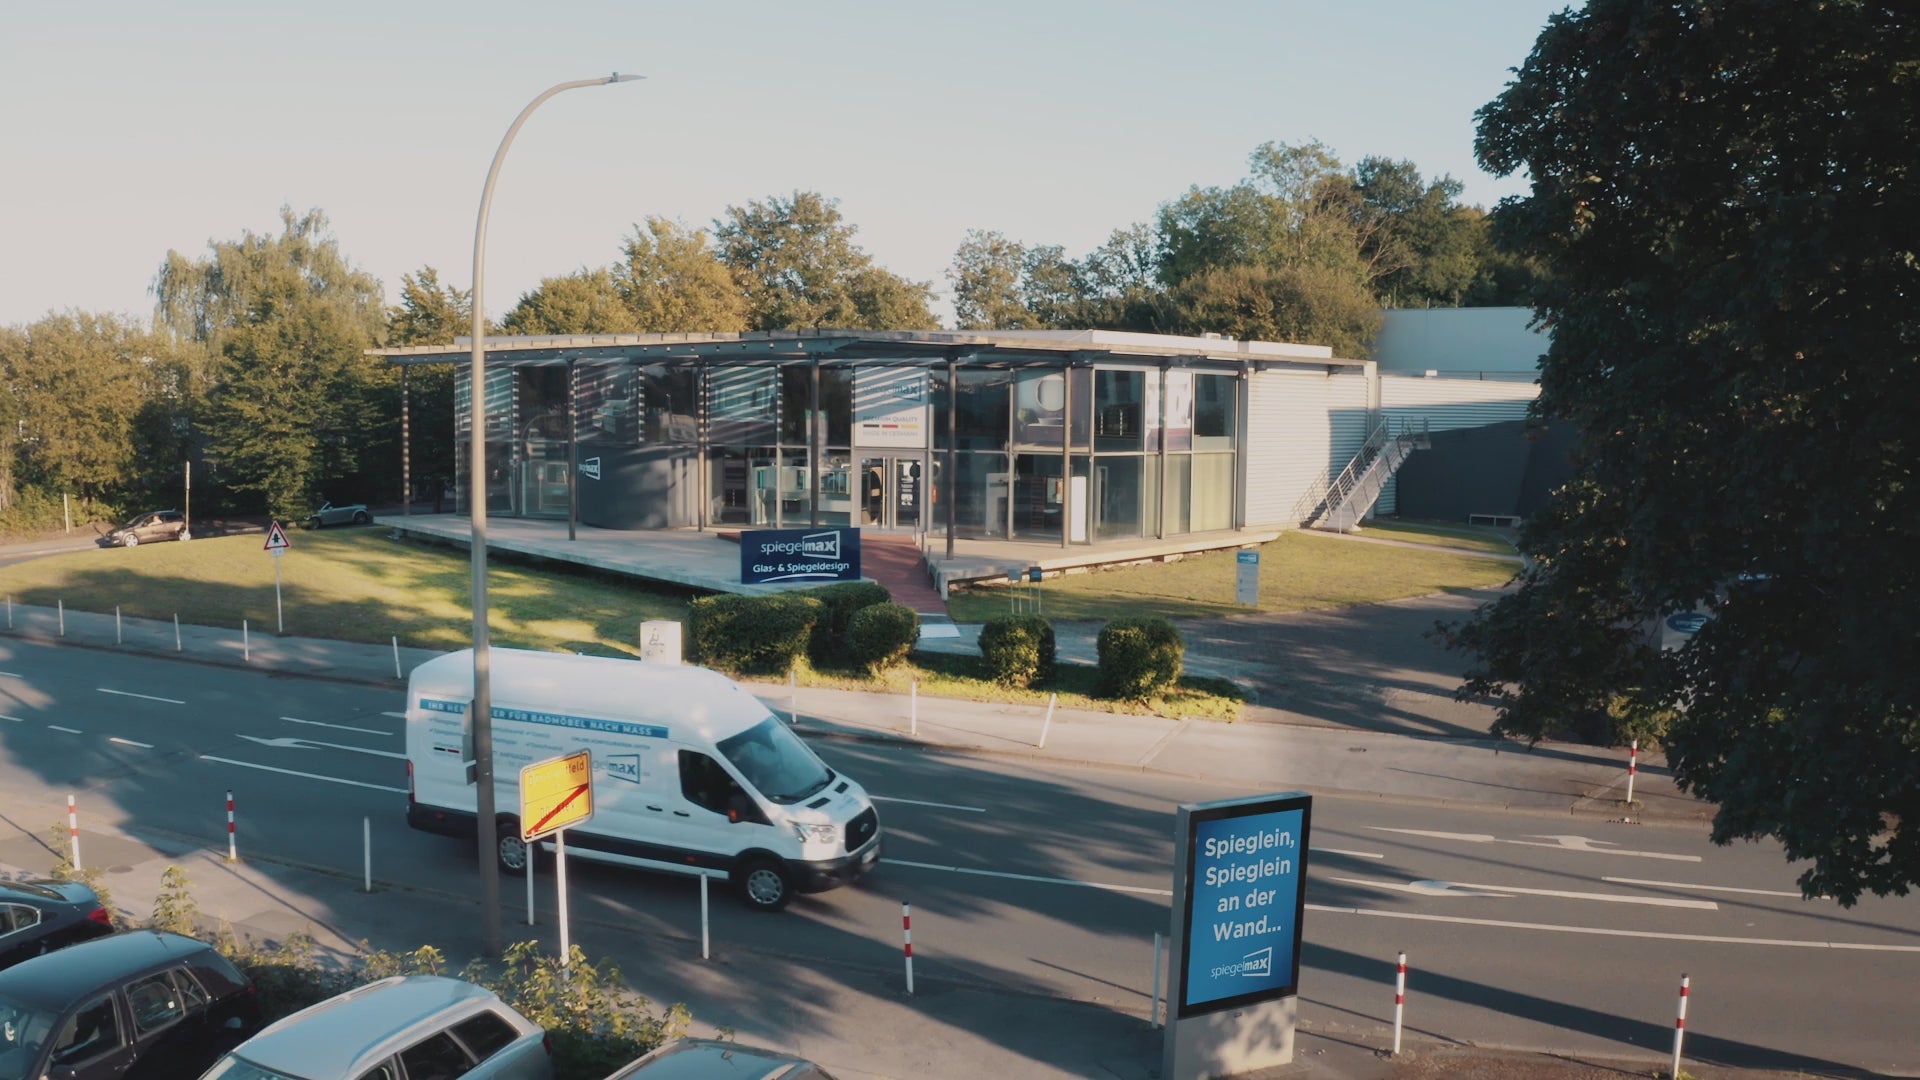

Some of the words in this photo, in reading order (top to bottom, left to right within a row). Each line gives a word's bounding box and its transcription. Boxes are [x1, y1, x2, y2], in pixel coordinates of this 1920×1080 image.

[760, 537, 837, 556] spiegelmax
[752, 563, 776, 573] Glas-
[777, 564, 785, 572] &
[787, 561, 850, 574] Spiegeldesign
[428, 702, 445, 710] IHR
[509, 710, 528, 721] FÜR
[531, 714, 587, 729] BADMÖBEL
[590, 721, 619, 732] NACH
[623, 725, 653, 736] MASS
[1204, 828, 1296, 859] Spieglein,
[1205, 857, 1291, 888] Spieglein
[1217, 894, 1240, 913] an
[1245, 888, 1277, 908] der
[1213, 916, 1282, 942] Wand...
[1210, 957, 1269, 980] spiegelmax
